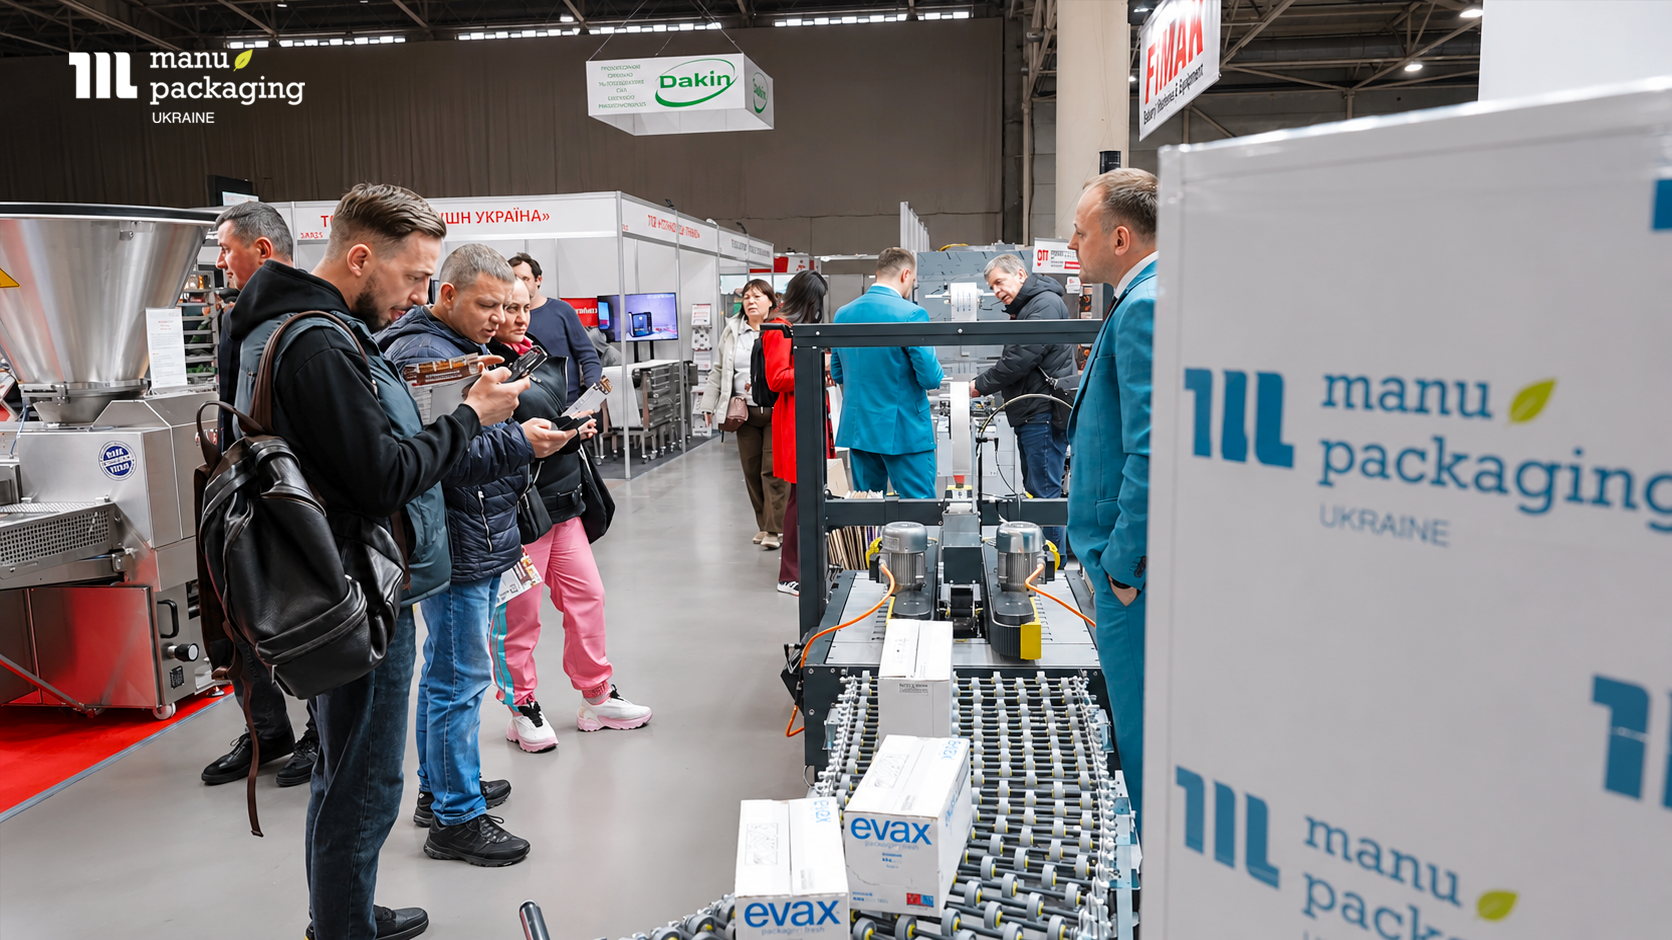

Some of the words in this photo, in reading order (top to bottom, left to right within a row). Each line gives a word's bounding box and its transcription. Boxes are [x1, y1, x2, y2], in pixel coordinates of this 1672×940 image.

[659, 70, 731, 89] Dakin
[475, 208, 551, 224] УКРАЇНА»
[1320, 372, 1495, 420] manu
[1317, 435, 1672, 534] packaging
[1318, 503, 1451, 548] UKRAINE
[850, 817, 933, 846] evax
[1303, 814, 1463, 909] manu
[744, 900, 841, 928] evax
[1302, 872, 1468, 940] pack
